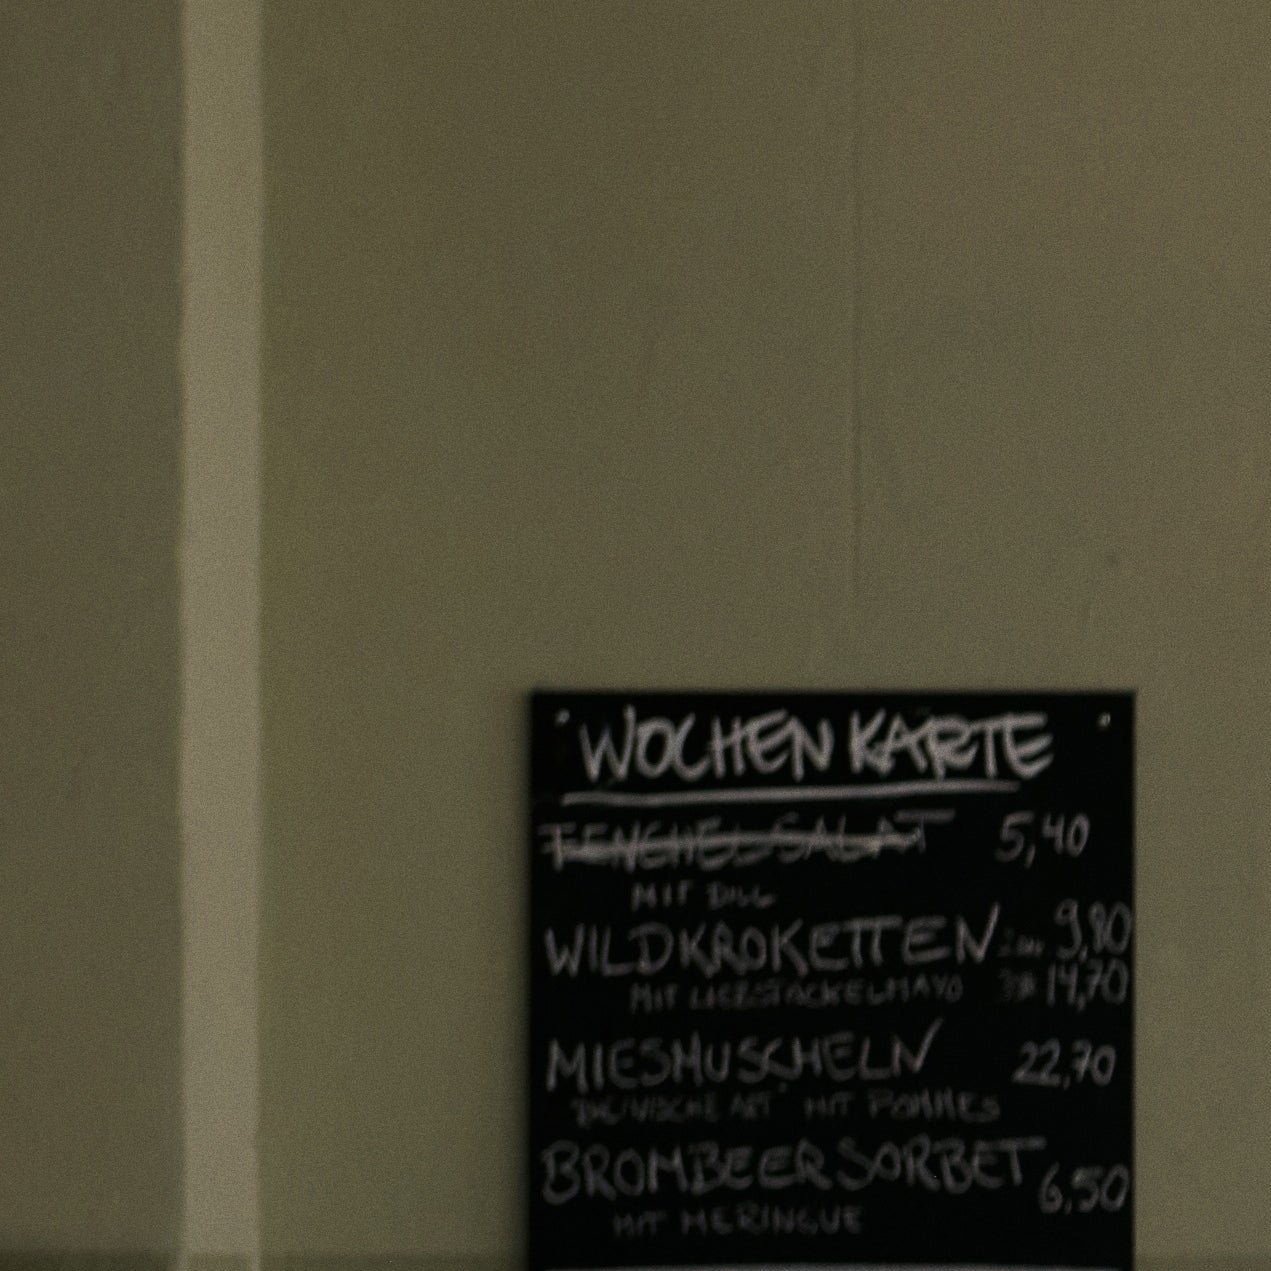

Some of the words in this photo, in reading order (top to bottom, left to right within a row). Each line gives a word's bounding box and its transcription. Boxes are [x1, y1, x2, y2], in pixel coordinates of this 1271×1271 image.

[995, 811, 1089, 867] 5,40
[630, 880, 693, 912] MIT
[544, 901, 999, 977] WILDKROKETTEN
[629, 980, 678, 1013] MIT
[547, 1018, 942, 1092] MIESMUSCHELN
[1012, 1040, 1116, 1089] 22,70
[1038, 1163, 1132, 1214] 6,50
[614, 1208, 668, 1239] MIT
[680, 1201, 864, 1236] MERINGUE
